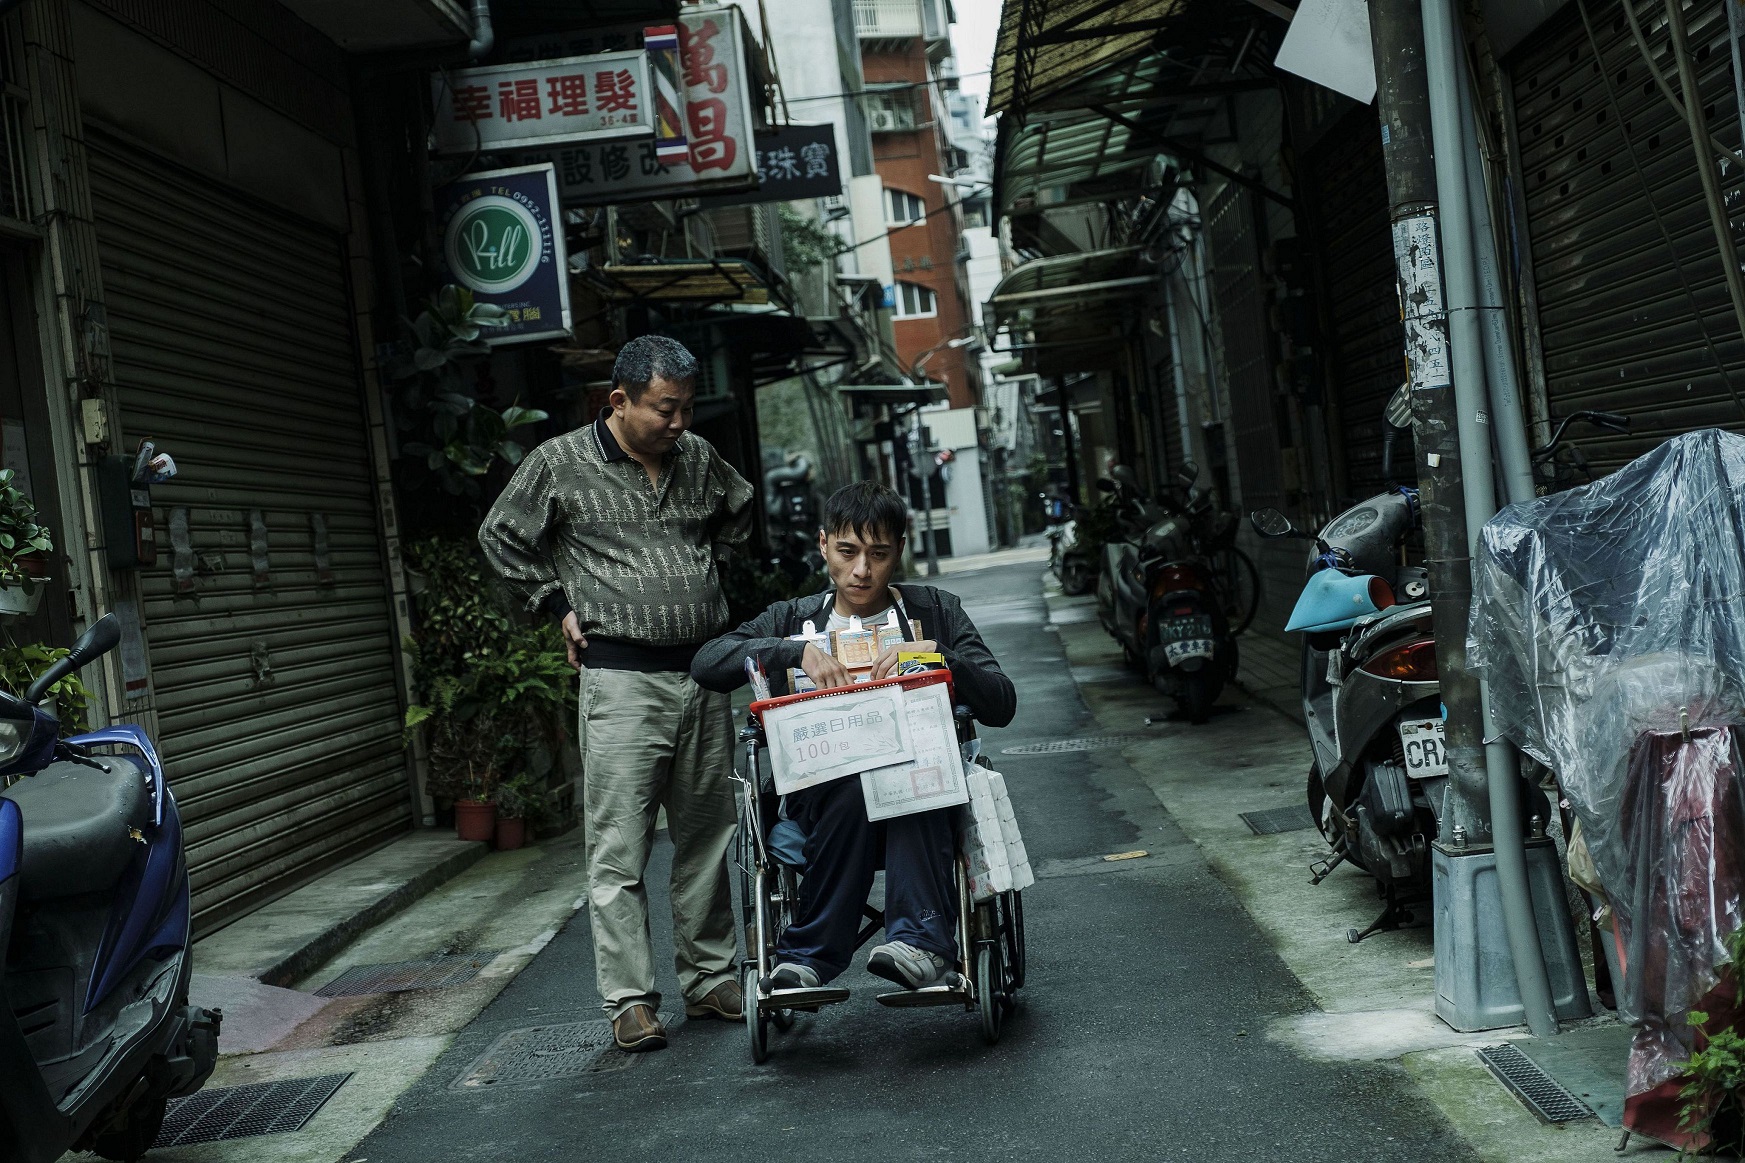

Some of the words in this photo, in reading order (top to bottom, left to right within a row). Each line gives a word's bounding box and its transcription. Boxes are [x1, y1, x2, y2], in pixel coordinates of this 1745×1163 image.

[453, 68, 638, 123] 幸福理髮
[676, 18, 736, 174] 萬昌
[490, 186, 511, 198] TEL
[793, 710, 883, 743] 嚴選日用品
